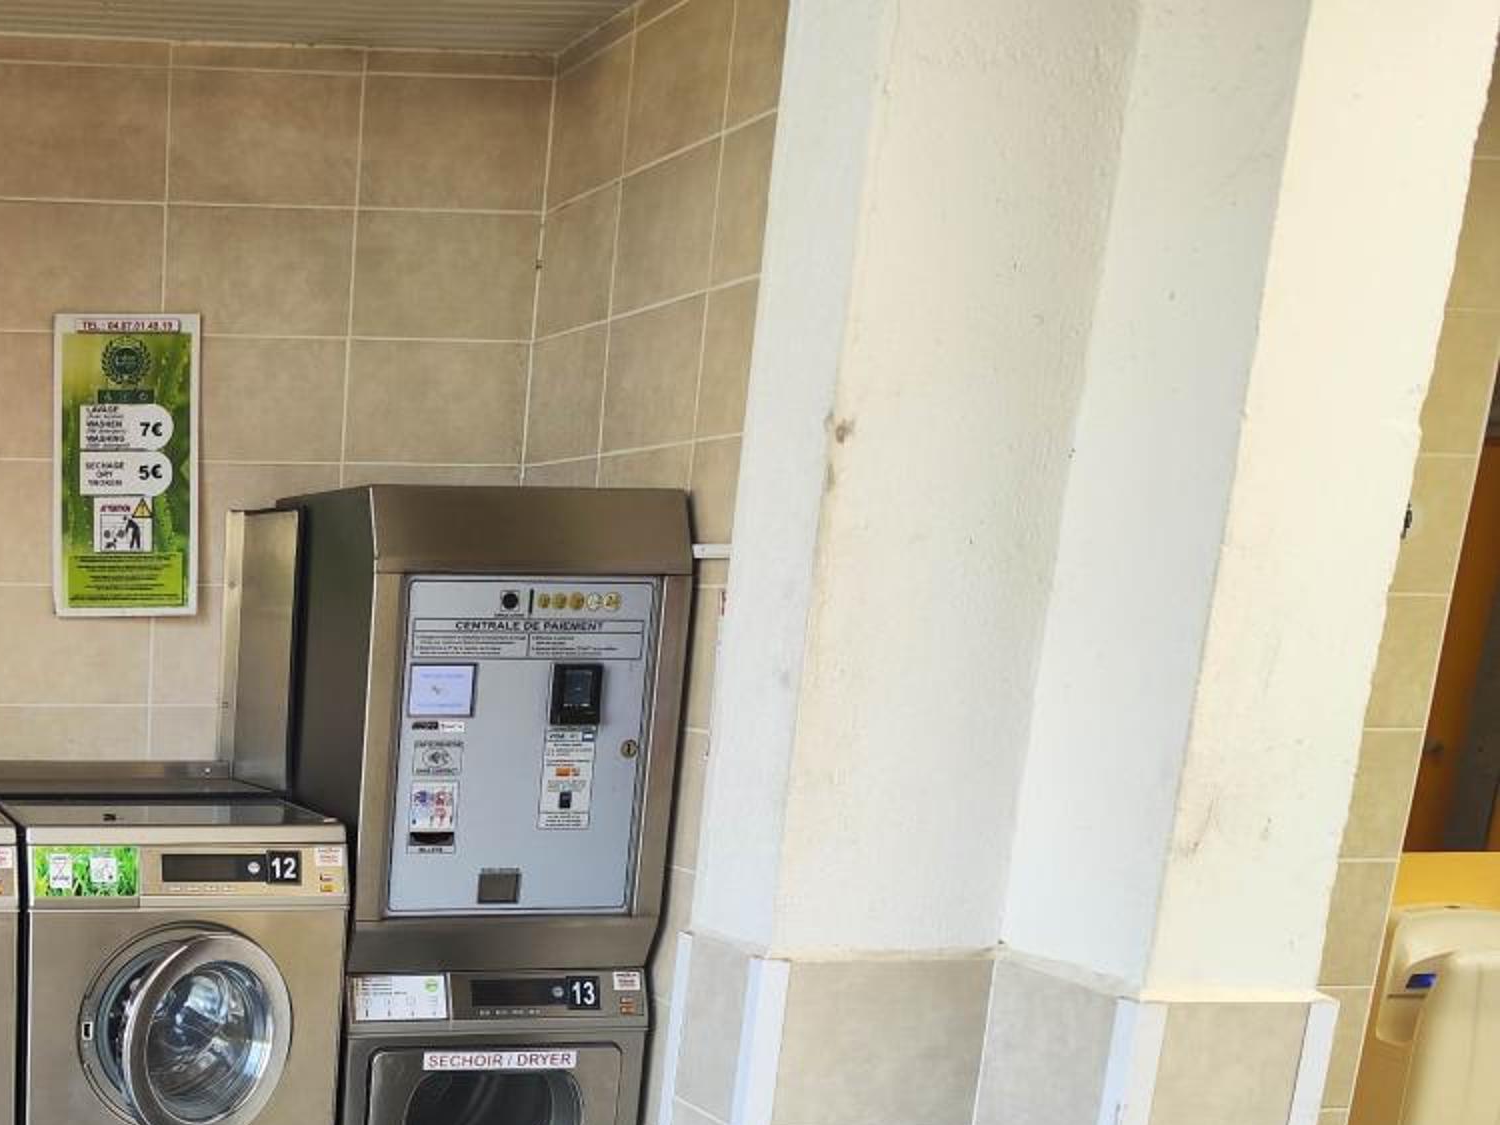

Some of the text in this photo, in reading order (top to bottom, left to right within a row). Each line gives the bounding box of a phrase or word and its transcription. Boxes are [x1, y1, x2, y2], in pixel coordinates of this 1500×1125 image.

[140, 422, 163, 437] 7€
[139, 464, 163, 480] 5€
[455, 621, 603, 631] CENTRALE DE PAIEMENT
[271, 856, 297, 879] 12
[571, 981, 596, 1005] 13
[428, 1053, 502, 1067] SECHOIR
[517, 1052, 571, 1066] DRYER
